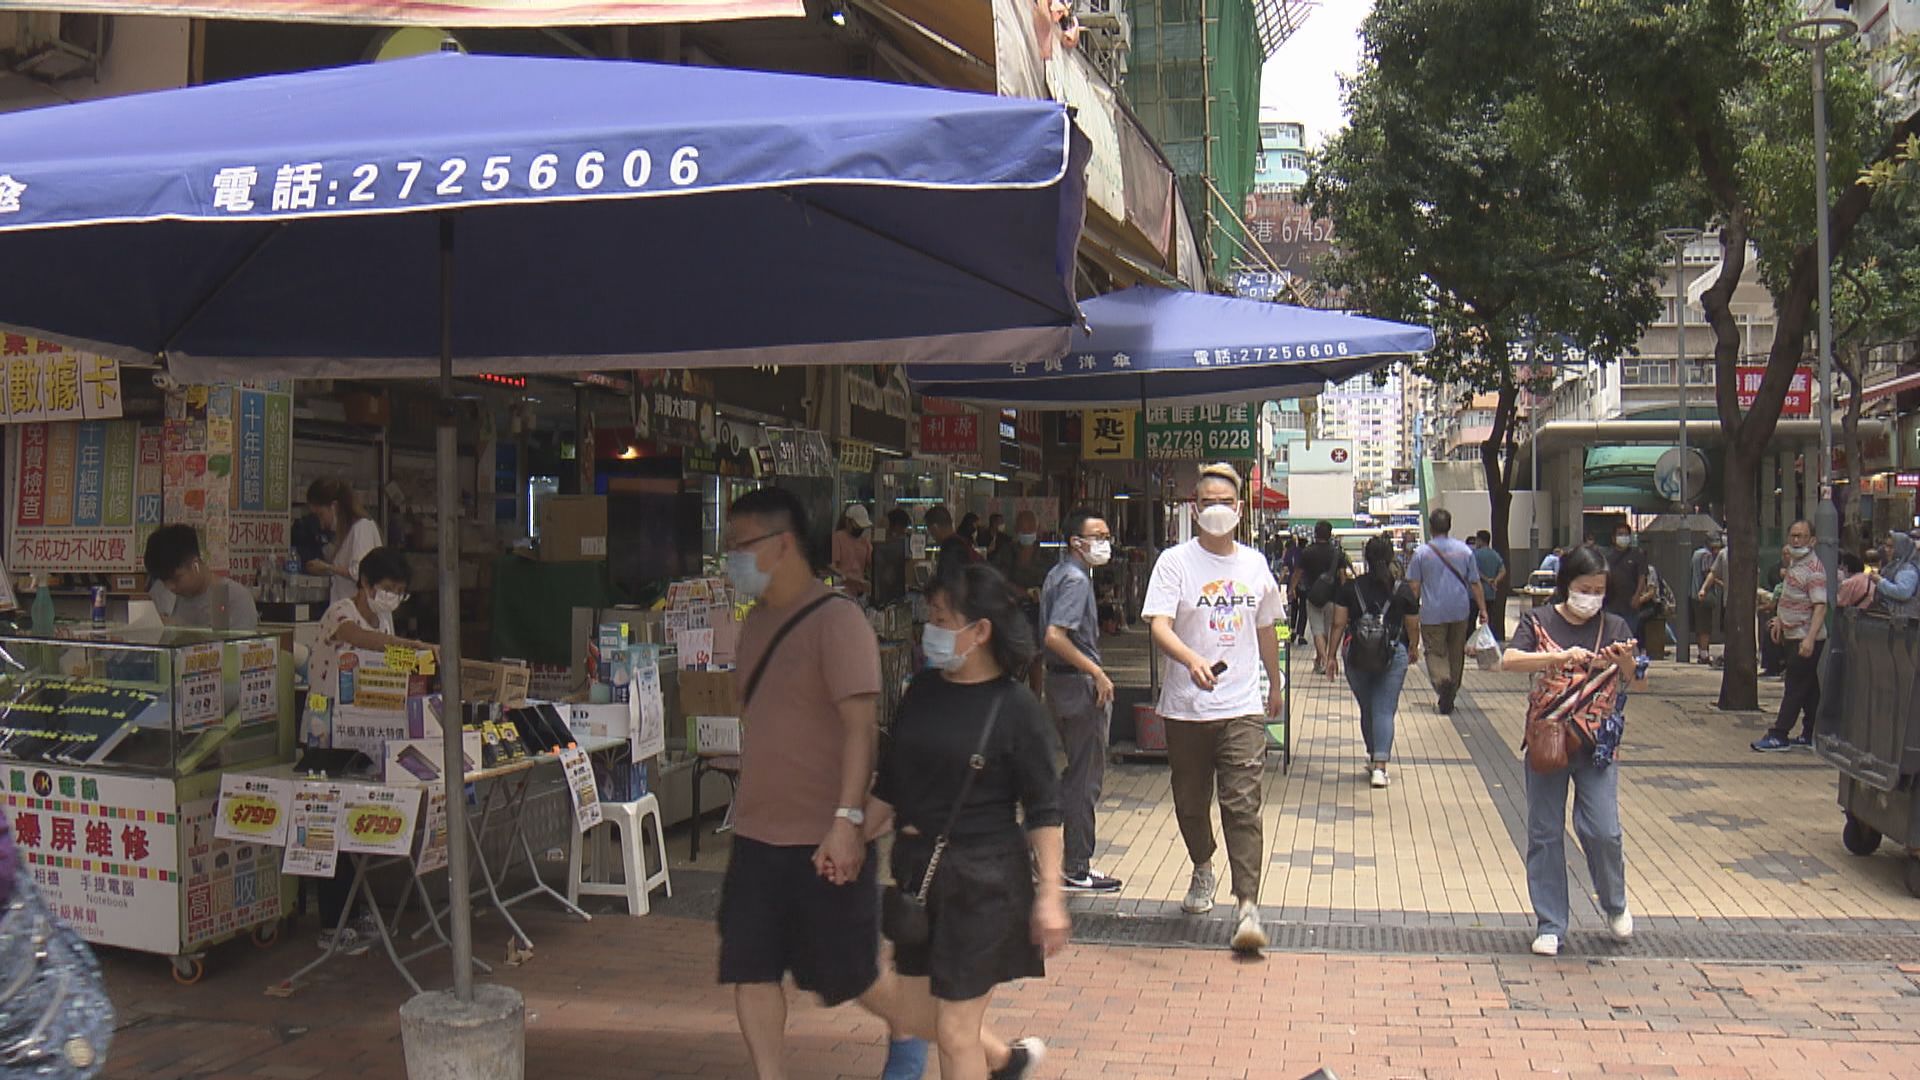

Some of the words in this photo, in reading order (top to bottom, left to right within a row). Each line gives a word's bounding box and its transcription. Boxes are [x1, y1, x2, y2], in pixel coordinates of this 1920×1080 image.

[213, 146, 700, 211] 電話:27256606
[1193, 342, 1348, 365] 電話:27256606
[0, 356, 117, 413] 數據卡
[1208, 430, 1250, 449] 6228
[244, 406, 261, 503] 十年經驗
[16, 537, 126, 561] 不成功不收費
[1196, 596, 1256, 607] AAPE
[232, 803, 277, 825] $799
[353, 813, 402, 836] $799
[15, 812, 149, 861] 爆屏維修
[80, 873, 135, 897] 手提電腦
[86, 893, 129, 909] Notebook
